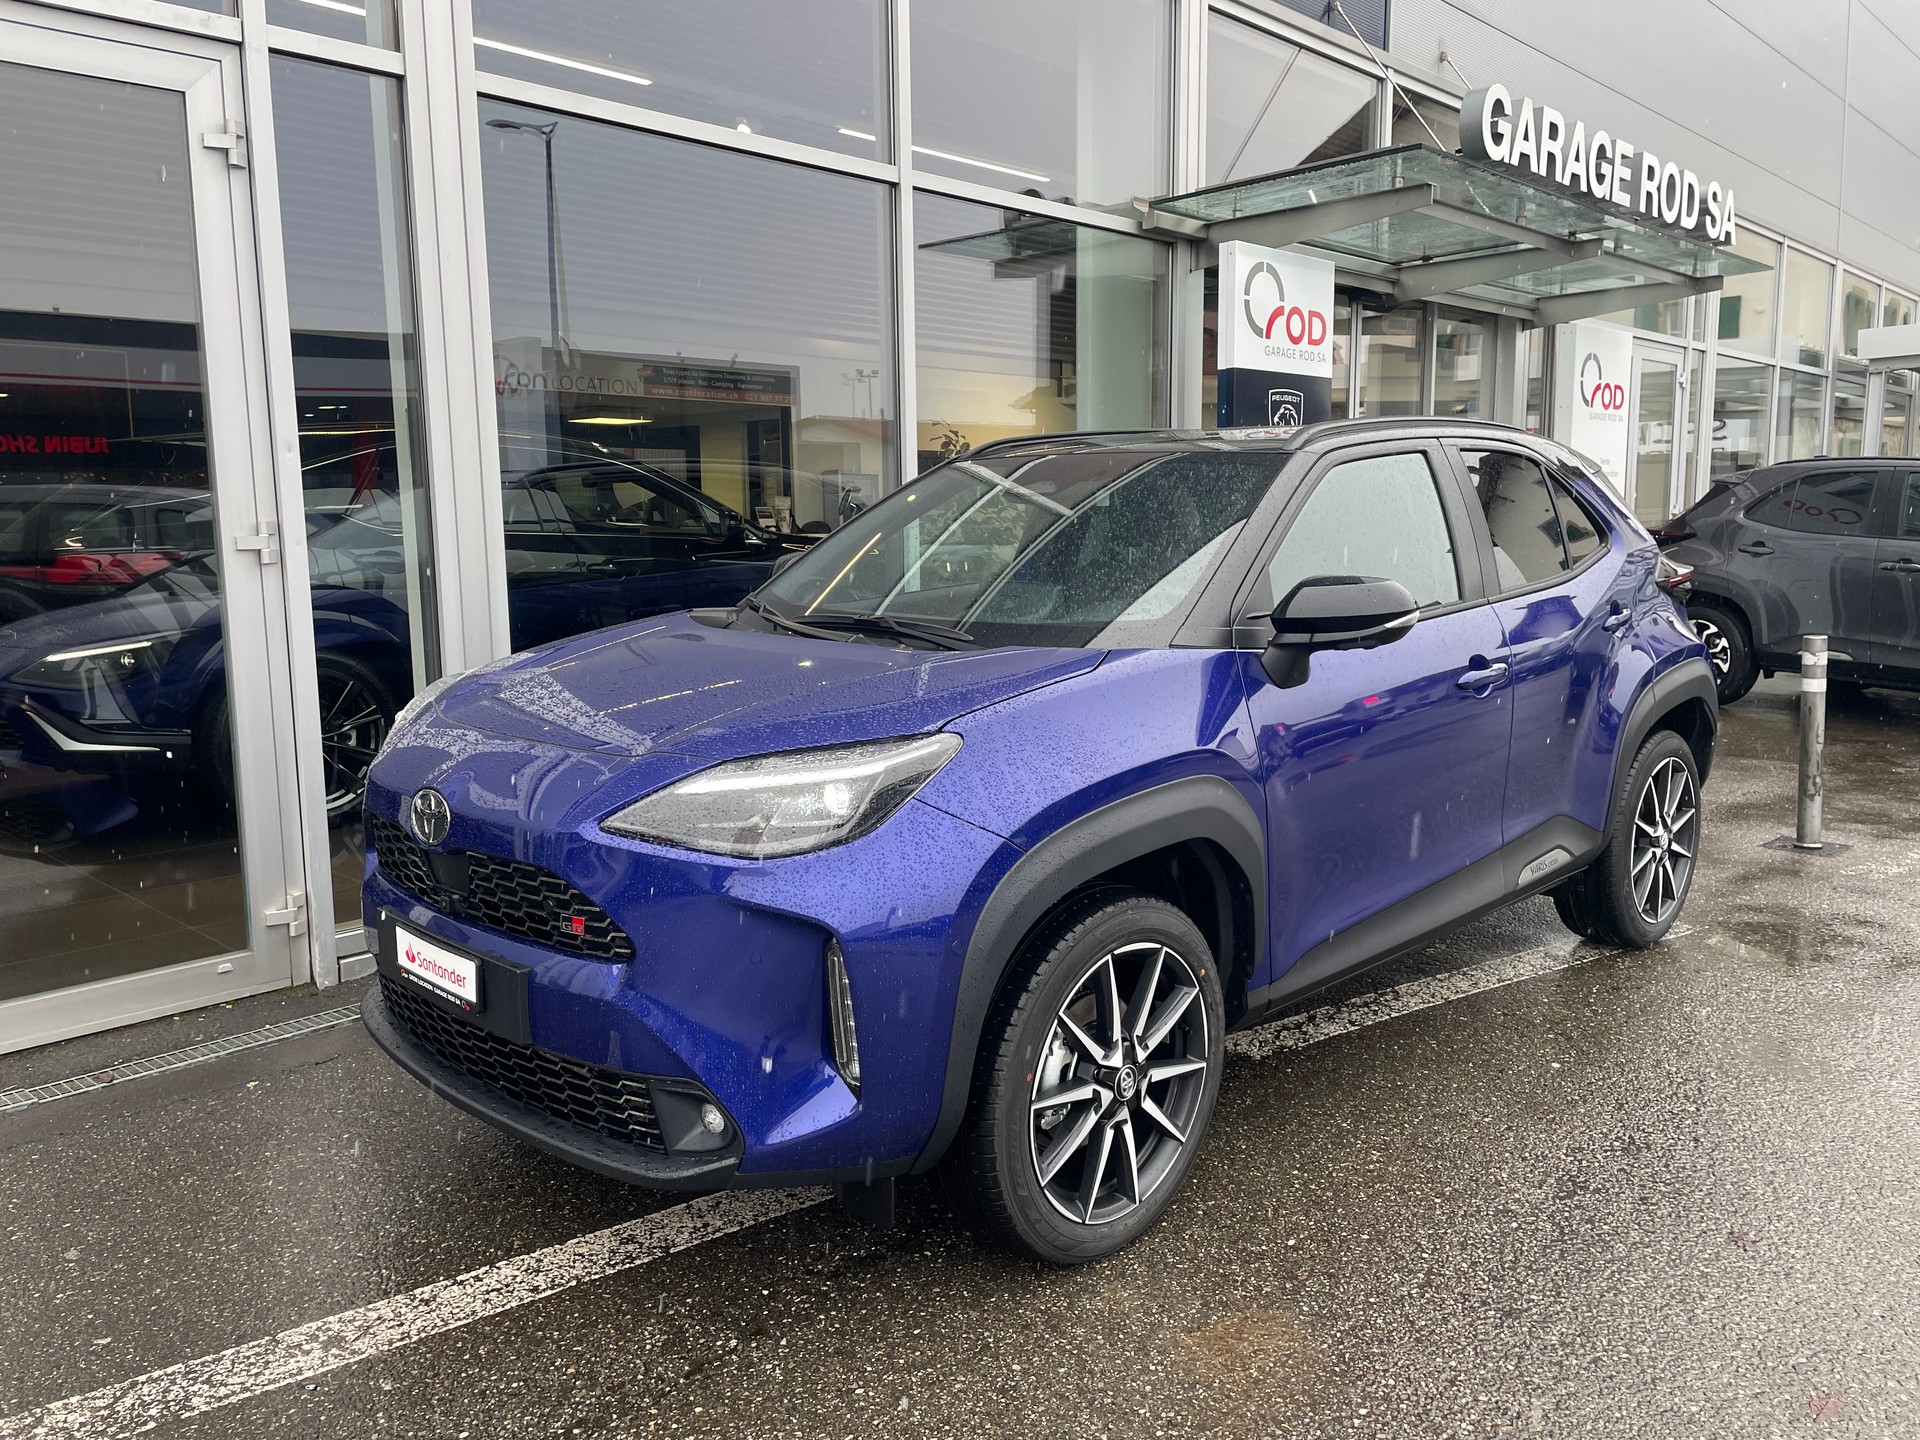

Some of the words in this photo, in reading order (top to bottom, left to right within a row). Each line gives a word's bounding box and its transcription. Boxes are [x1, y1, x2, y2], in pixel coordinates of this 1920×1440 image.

[1482, 83, 1634, 208] GARAGE
[1639, 151, 1700, 231] ROD
[1705, 181, 1737, 246] SA
[1264, 345, 1297, 360] GARAGE
[1299, 349, 1315, 362] ROD
[1317, 352, 1326, 363] SA
[552, 373, 637, 395] LOCATION
[711, 380, 734, 388] Camping
[1271, 394, 1300, 403] PEUGEOT
[1529, 859, 1548, 876] YARIS
[562, 922, 583, 933] GR
[416, 951, 467, 989] Santander
